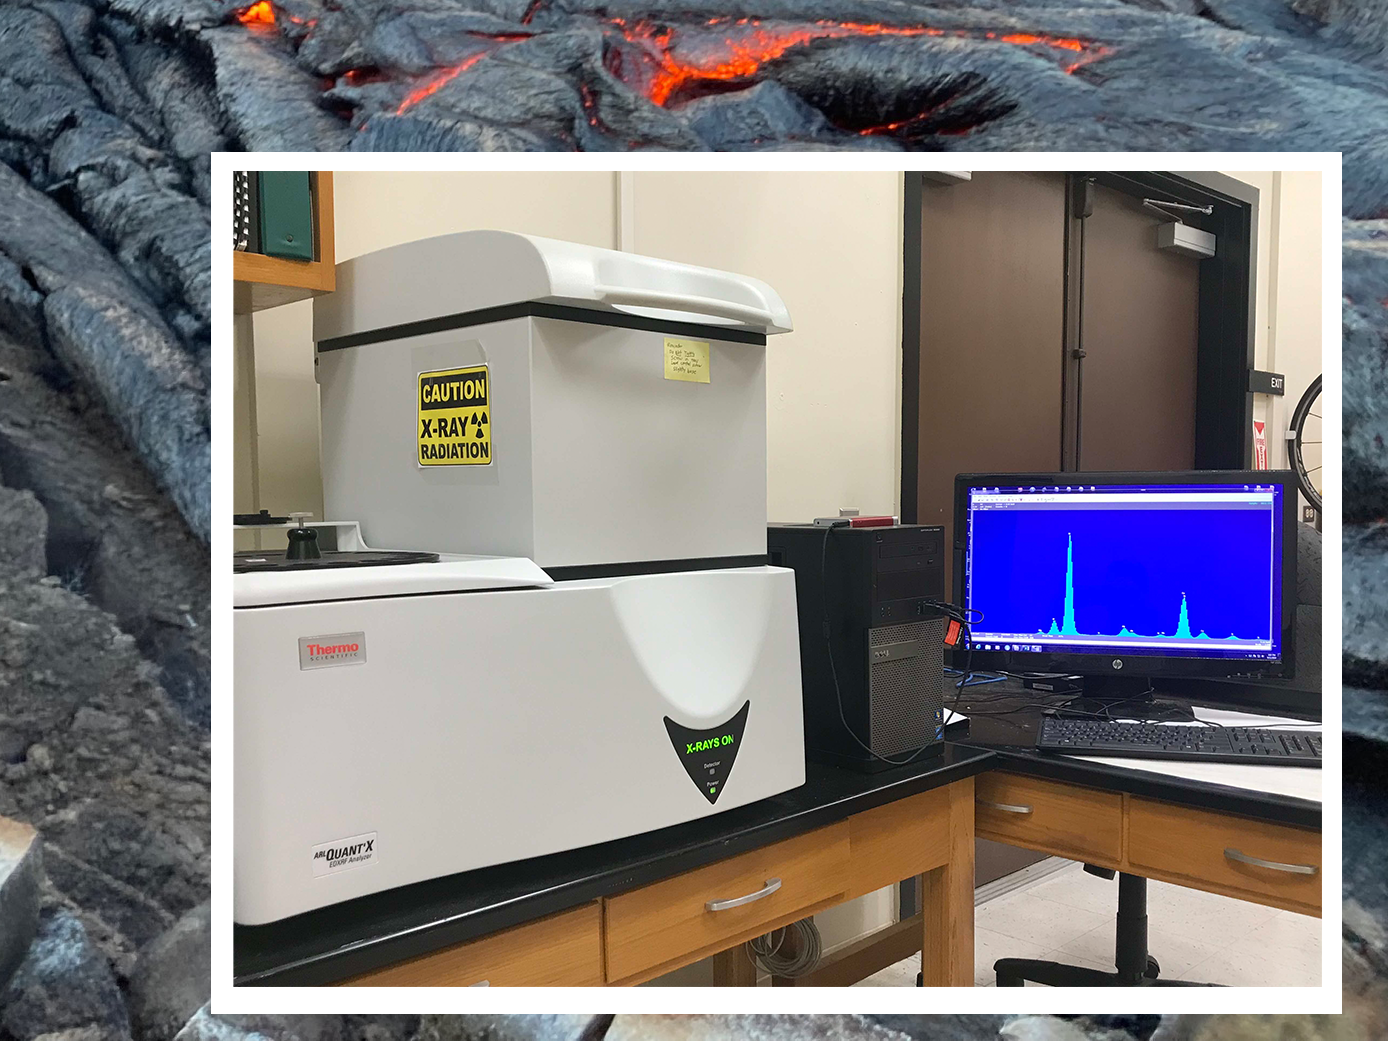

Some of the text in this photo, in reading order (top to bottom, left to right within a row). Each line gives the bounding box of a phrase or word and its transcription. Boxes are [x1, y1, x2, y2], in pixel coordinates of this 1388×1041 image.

[422, 379, 485, 403] CAUTION
[1271, 377, 1283, 389] EXIT
[420, 416, 469, 439] X-RAY
[420, 441, 489, 460] RADIATION
[306, 643, 359, 657] Thermo
[310, 652, 358, 662] SCIENTIFIC
[686, 734, 734, 754] X-RAYS ON
[347, 853, 372, 864] Analyzer
